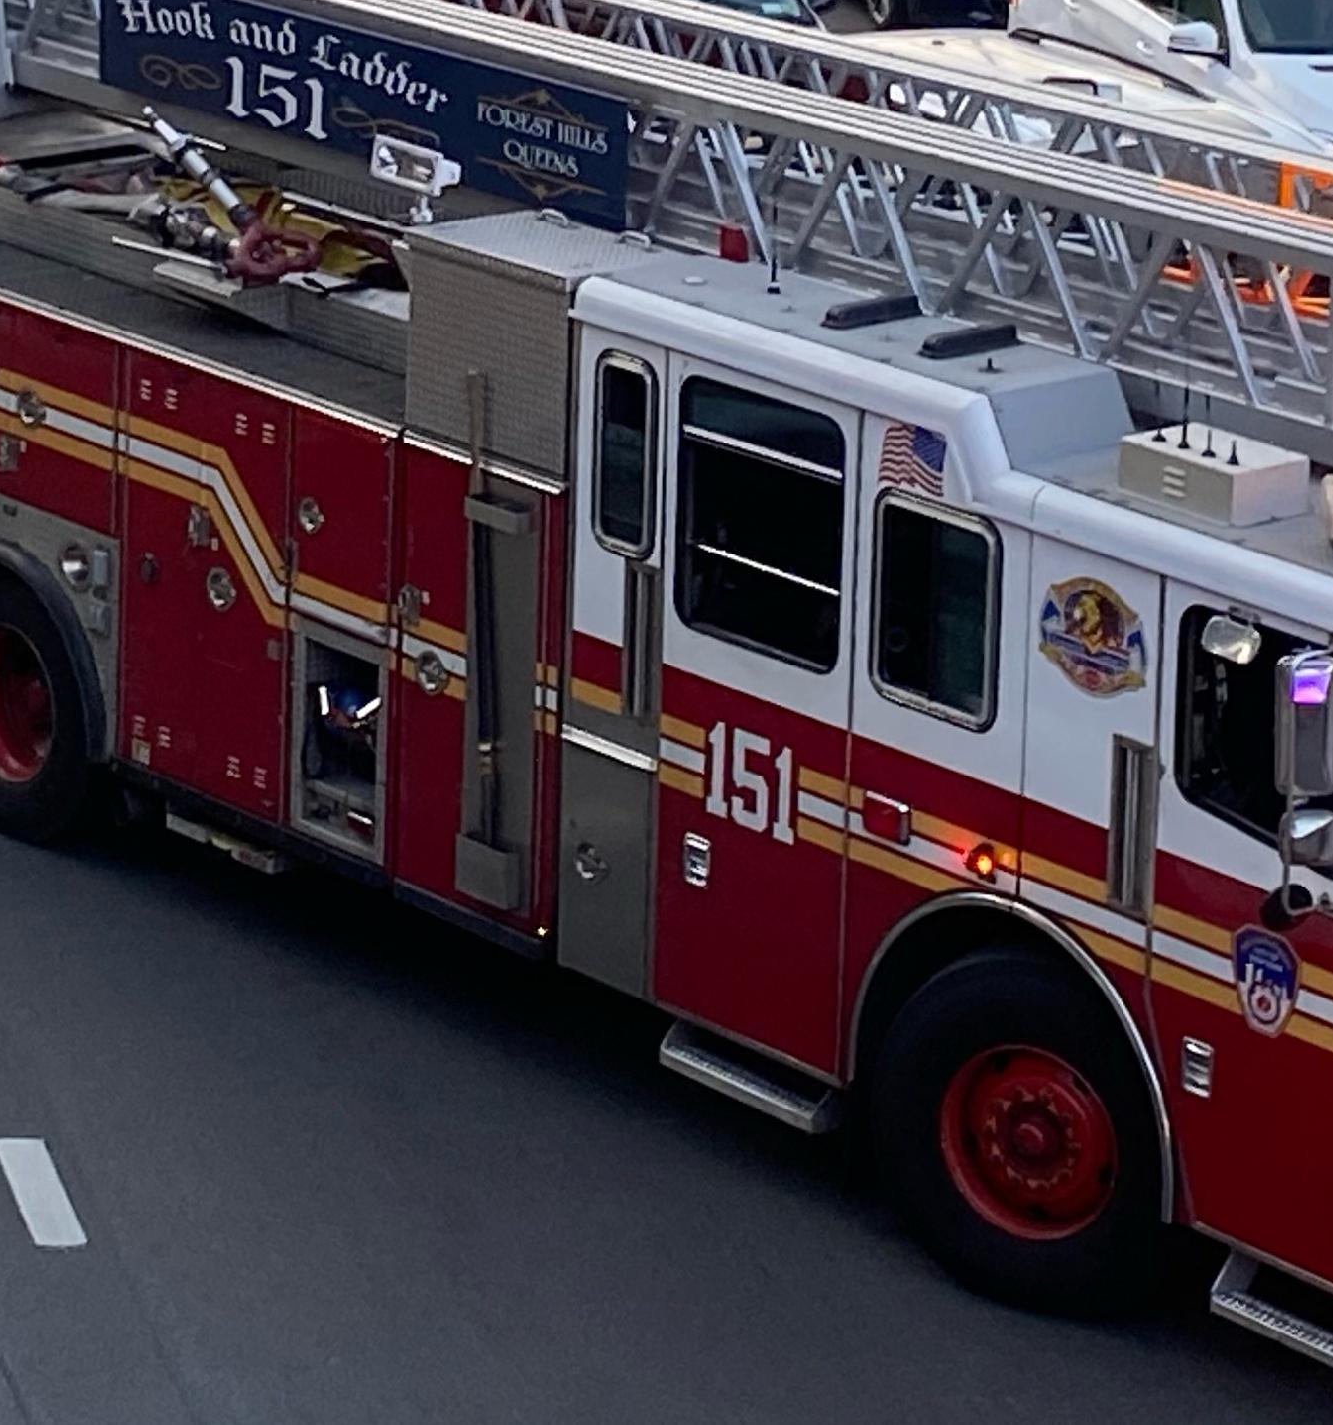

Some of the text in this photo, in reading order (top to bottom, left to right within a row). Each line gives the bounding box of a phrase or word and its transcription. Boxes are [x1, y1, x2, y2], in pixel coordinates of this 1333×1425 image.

[225, 56, 329, 140] 151
[229, 18, 297, 57] and
[309, 34, 449, 114] Ladder
[476, 101, 609, 155] FOREST HILLS
[502, 138, 579, 178] QUEENS
[703, 720, 795, 846] 151
